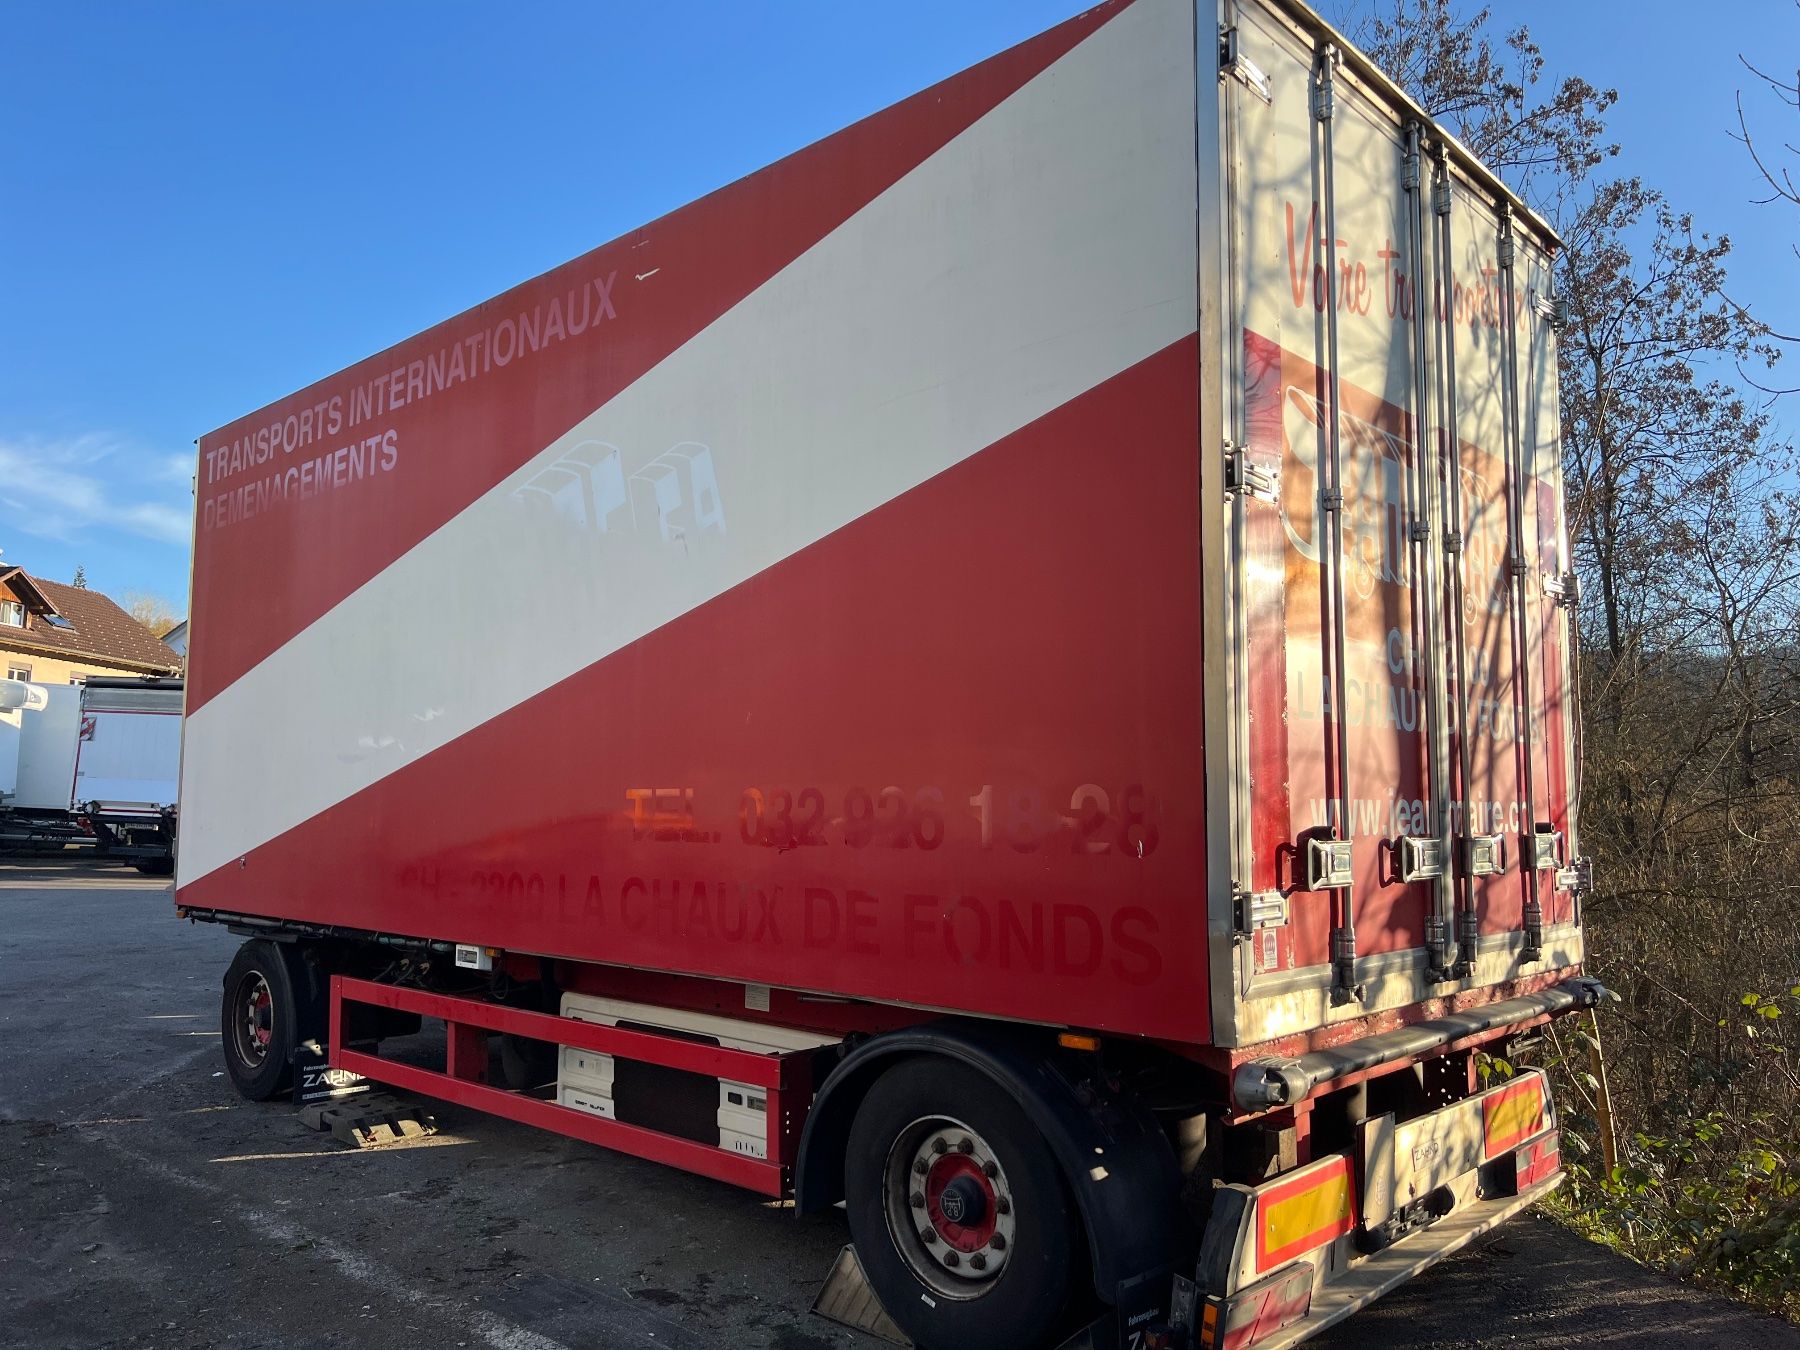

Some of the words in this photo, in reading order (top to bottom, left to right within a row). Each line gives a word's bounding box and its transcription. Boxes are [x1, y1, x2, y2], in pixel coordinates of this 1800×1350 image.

[206, 394, 342, 485] TRANSPORTS
[348, 270, 618, 429] INTERNATIONAUX
[203, 429, 399, 532] DEMENAGEMENTS
[1297, 670, 1339, 724] LA
[626, 787, 721, 842] TEL.
[558, 873, 607, 925] LA
[620, 876, 784, 946] CHAUX
[803, 886, 881, 956] DE
[903, 892, 1163, 987] FONDS
